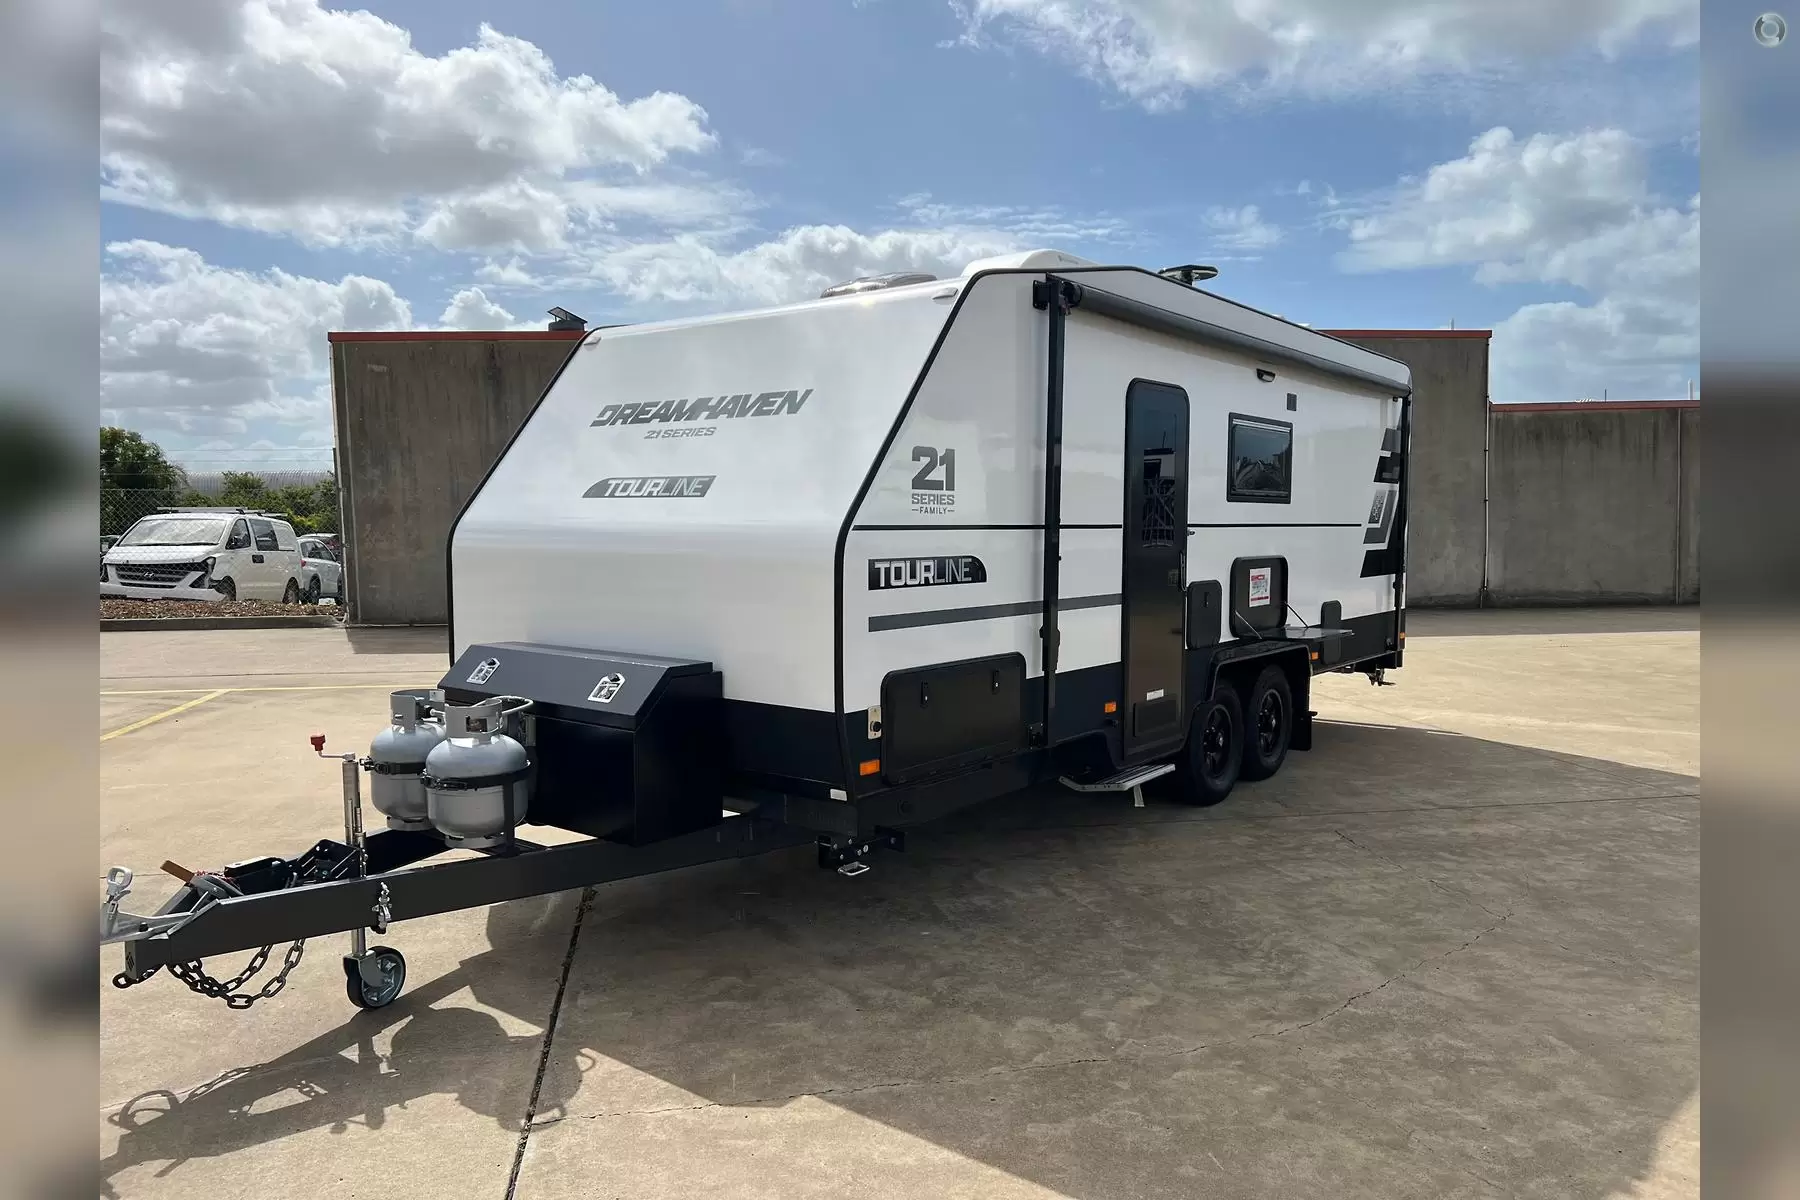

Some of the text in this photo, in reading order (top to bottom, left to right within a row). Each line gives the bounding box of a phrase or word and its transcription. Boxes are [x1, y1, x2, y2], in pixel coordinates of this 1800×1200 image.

[590, 389, 814, 427] DREAMHAVEN
[644, 426, 717, 439] 21 SERIES
[911, 445, 955, 491] 21
[604, 477, 705, 497] TOURLINE
[911, 493, 955, 505] SERIES
[874, 558, 973, 587] TOURLINE
